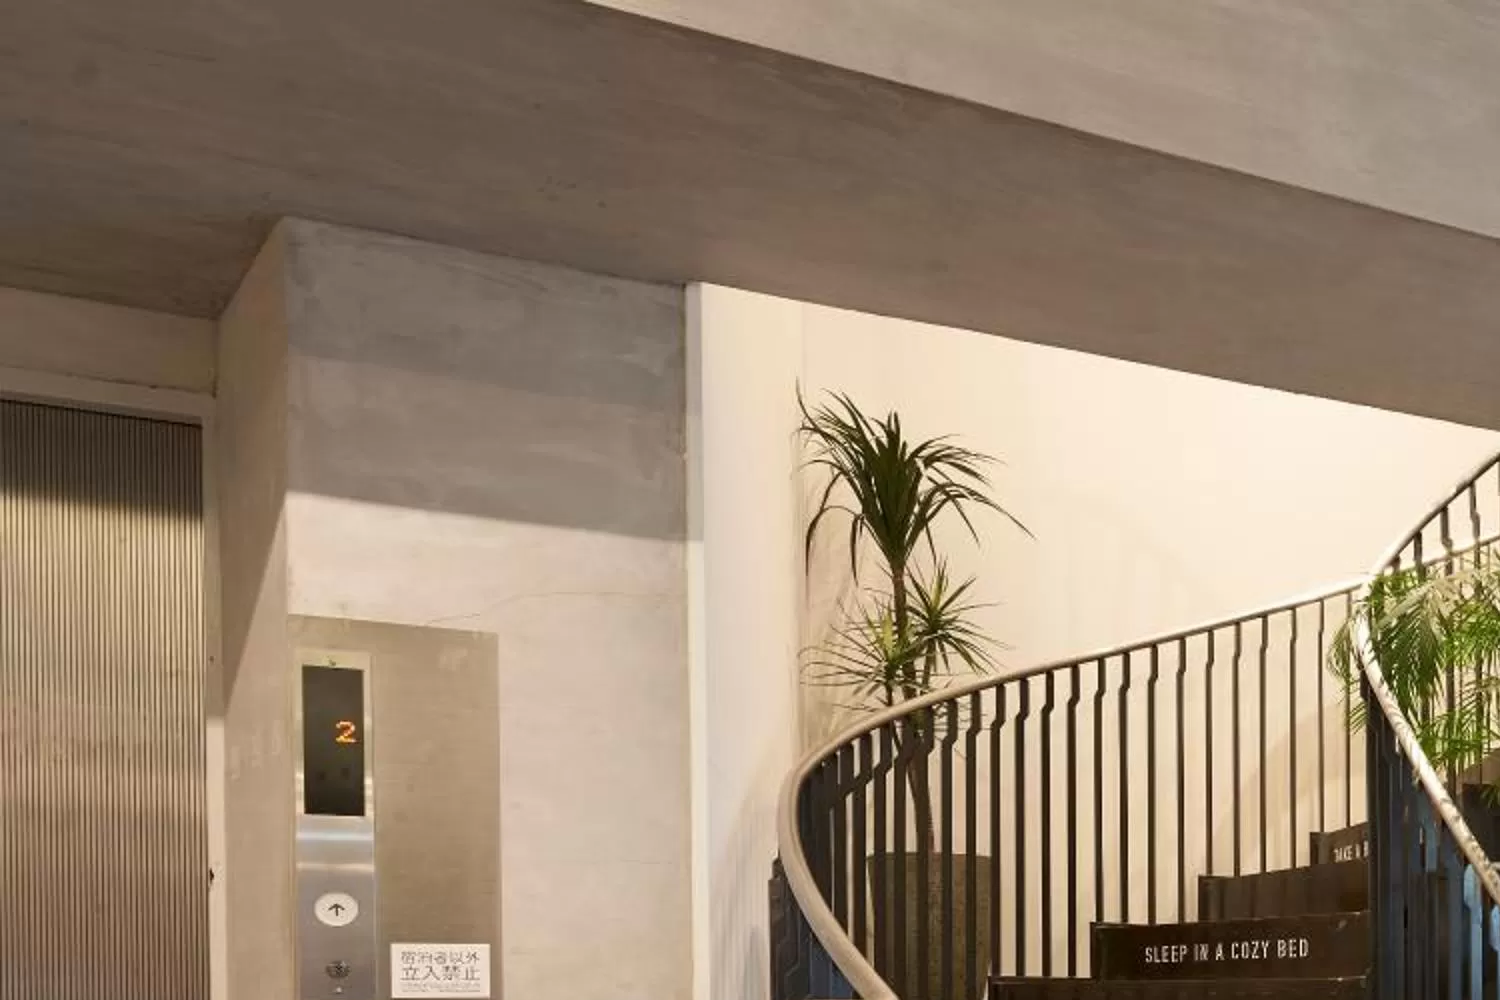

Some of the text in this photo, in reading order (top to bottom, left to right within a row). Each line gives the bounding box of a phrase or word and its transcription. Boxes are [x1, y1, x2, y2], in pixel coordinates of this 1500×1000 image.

[335, 720, 357, 743] 2
[1145, 938, 1309, 963] SLEEP IN A COZY BED
[400, 964, 480, 981] 立入禁止
